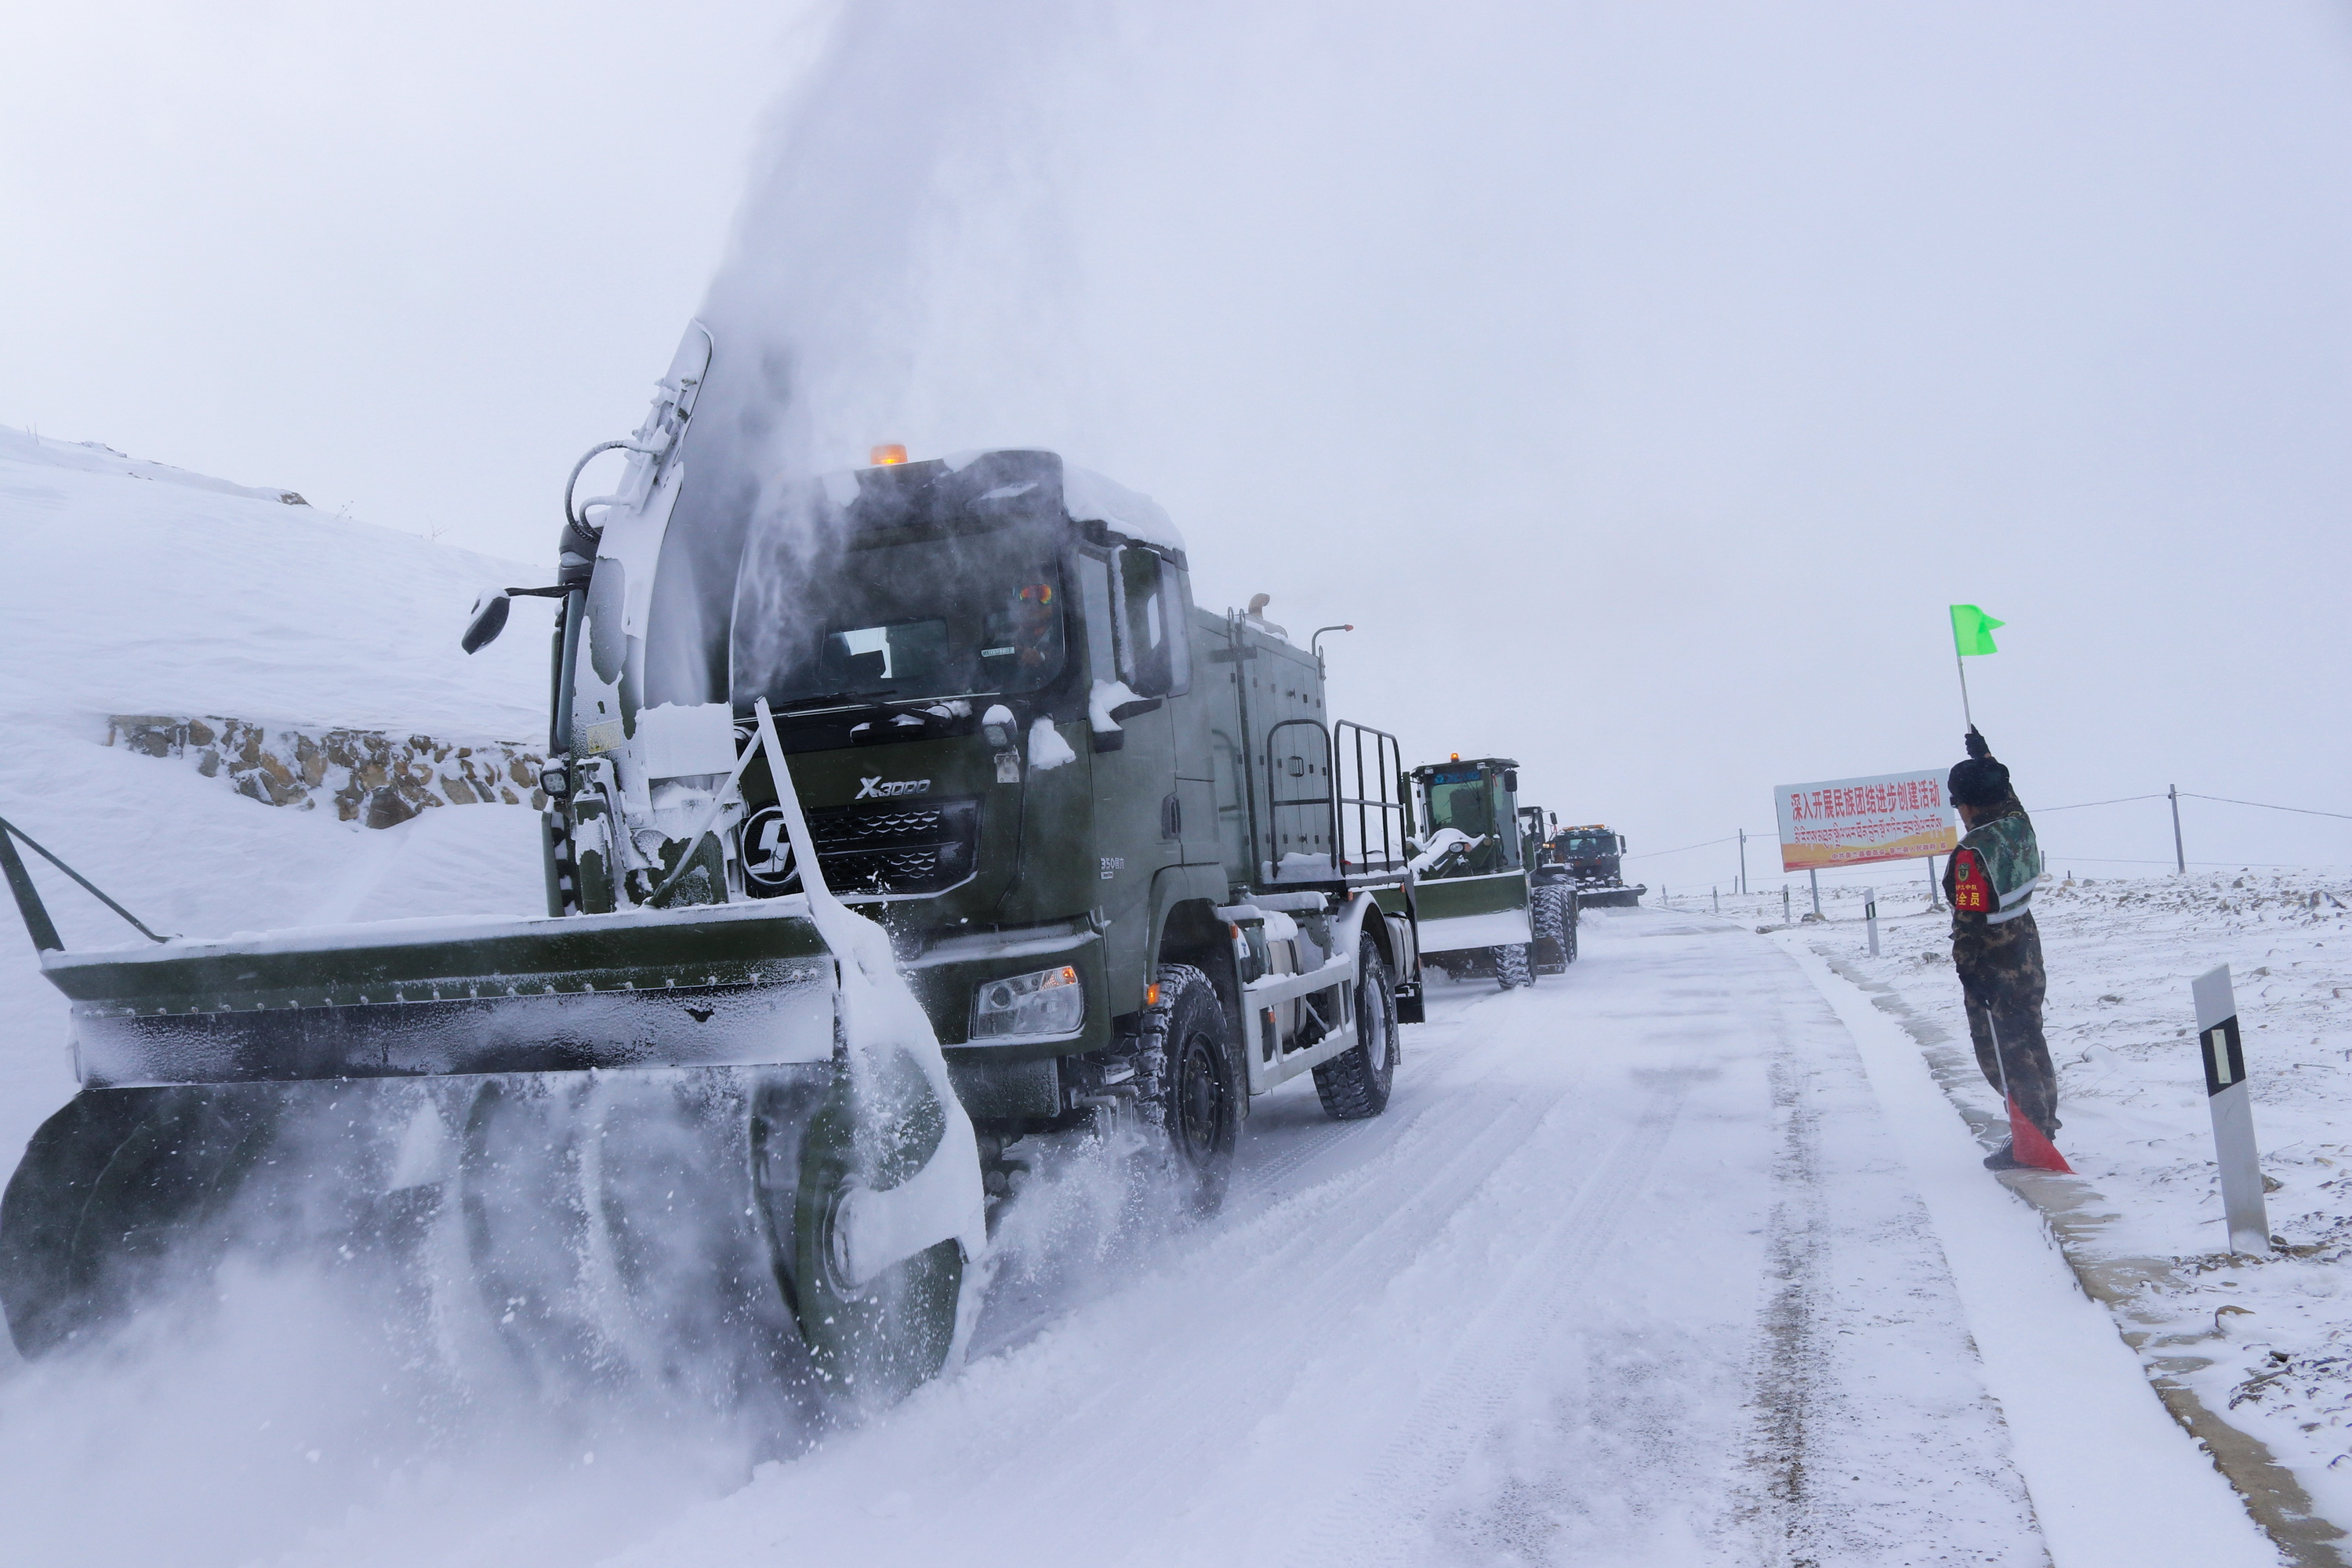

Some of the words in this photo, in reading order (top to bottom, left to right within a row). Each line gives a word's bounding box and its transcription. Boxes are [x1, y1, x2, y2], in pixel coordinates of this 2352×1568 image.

[855, 775, 931, 799] X3000
[1791, 778, 1940, 822] 深入开展民族团结进步创建活动
[1831, 848, 1886, 859] 中共普兰县委员会
[1889, 843, 1936, 855] 普兰县人民政府
[1955, 892, 1980, 906] 全员
